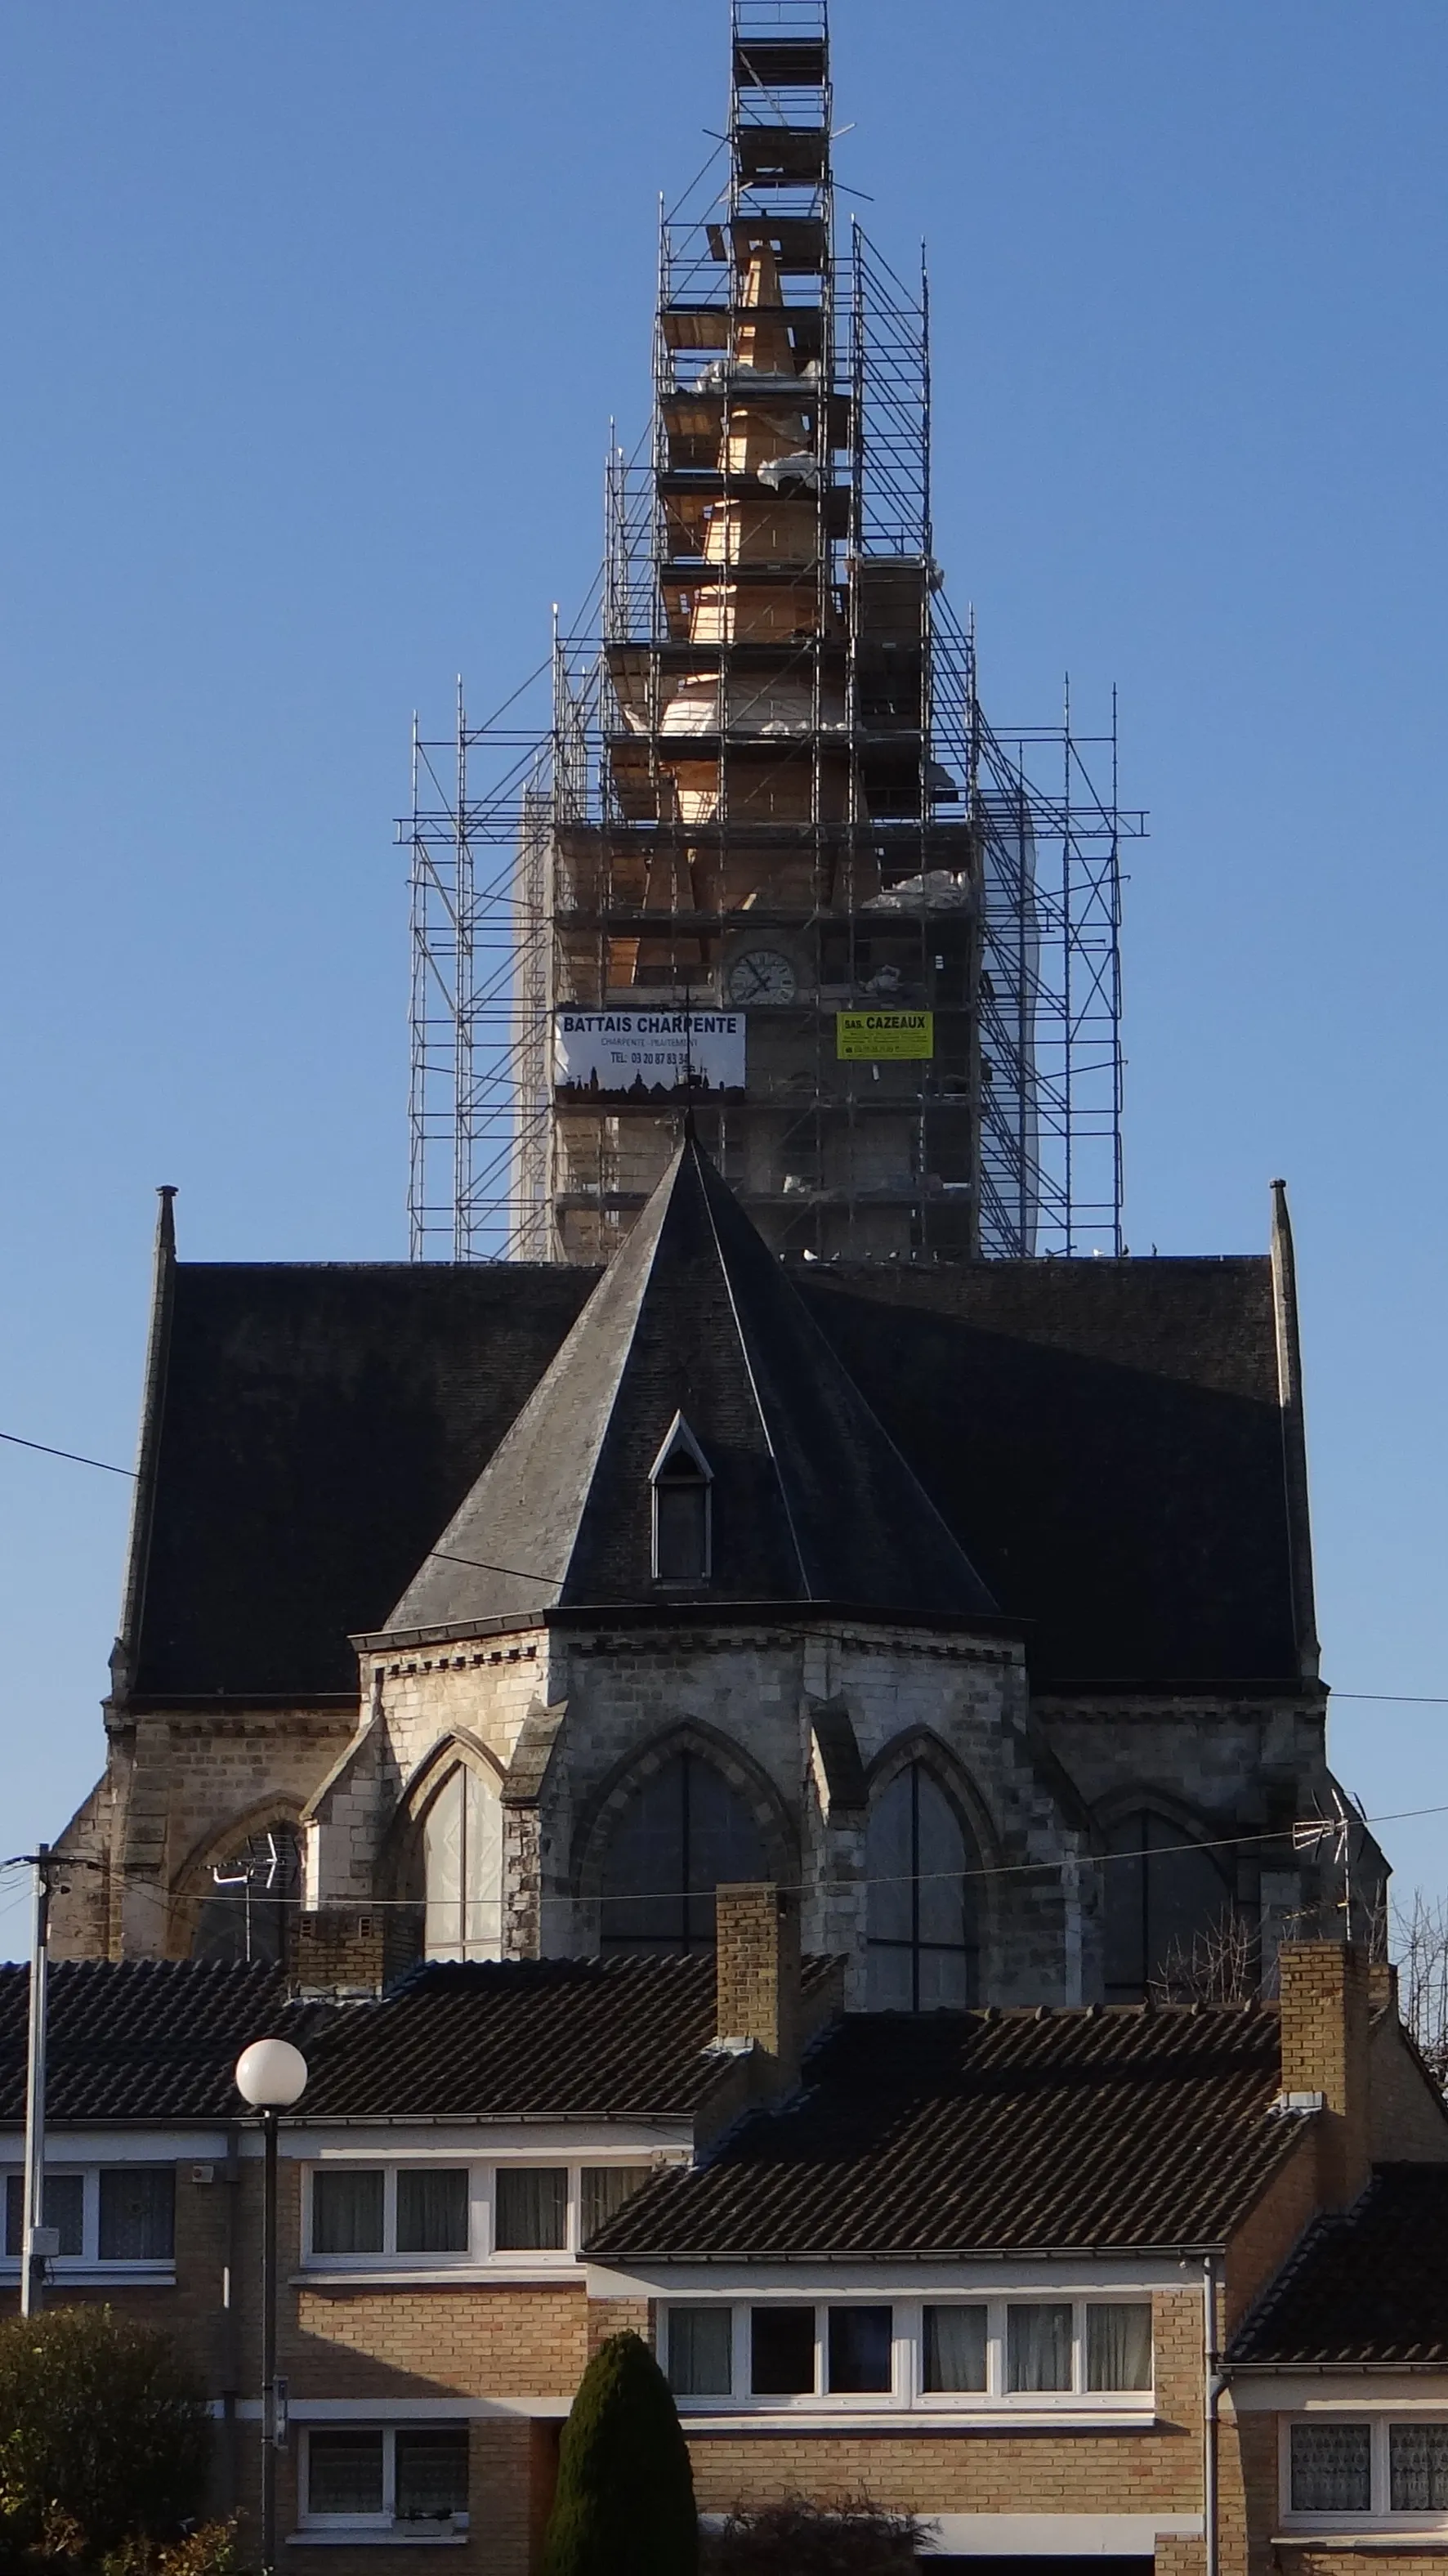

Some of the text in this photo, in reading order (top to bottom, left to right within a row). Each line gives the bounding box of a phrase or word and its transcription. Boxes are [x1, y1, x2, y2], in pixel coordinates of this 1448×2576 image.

[565, 1017, 736, 1033] BATTAIS CHARPENTE
[866, 1017, 925, 1029] CAZEAUX
[601, 1038, 645, 1047] CHARPENTE
[610, 1052, 628, 1063] TEL:
[632, 1053, 641, 1064] 03
[644, 1053, 654, 1064] 20
[655, 1053, 665, 1064] 87
[667, 1053, 677, 1064] 83
